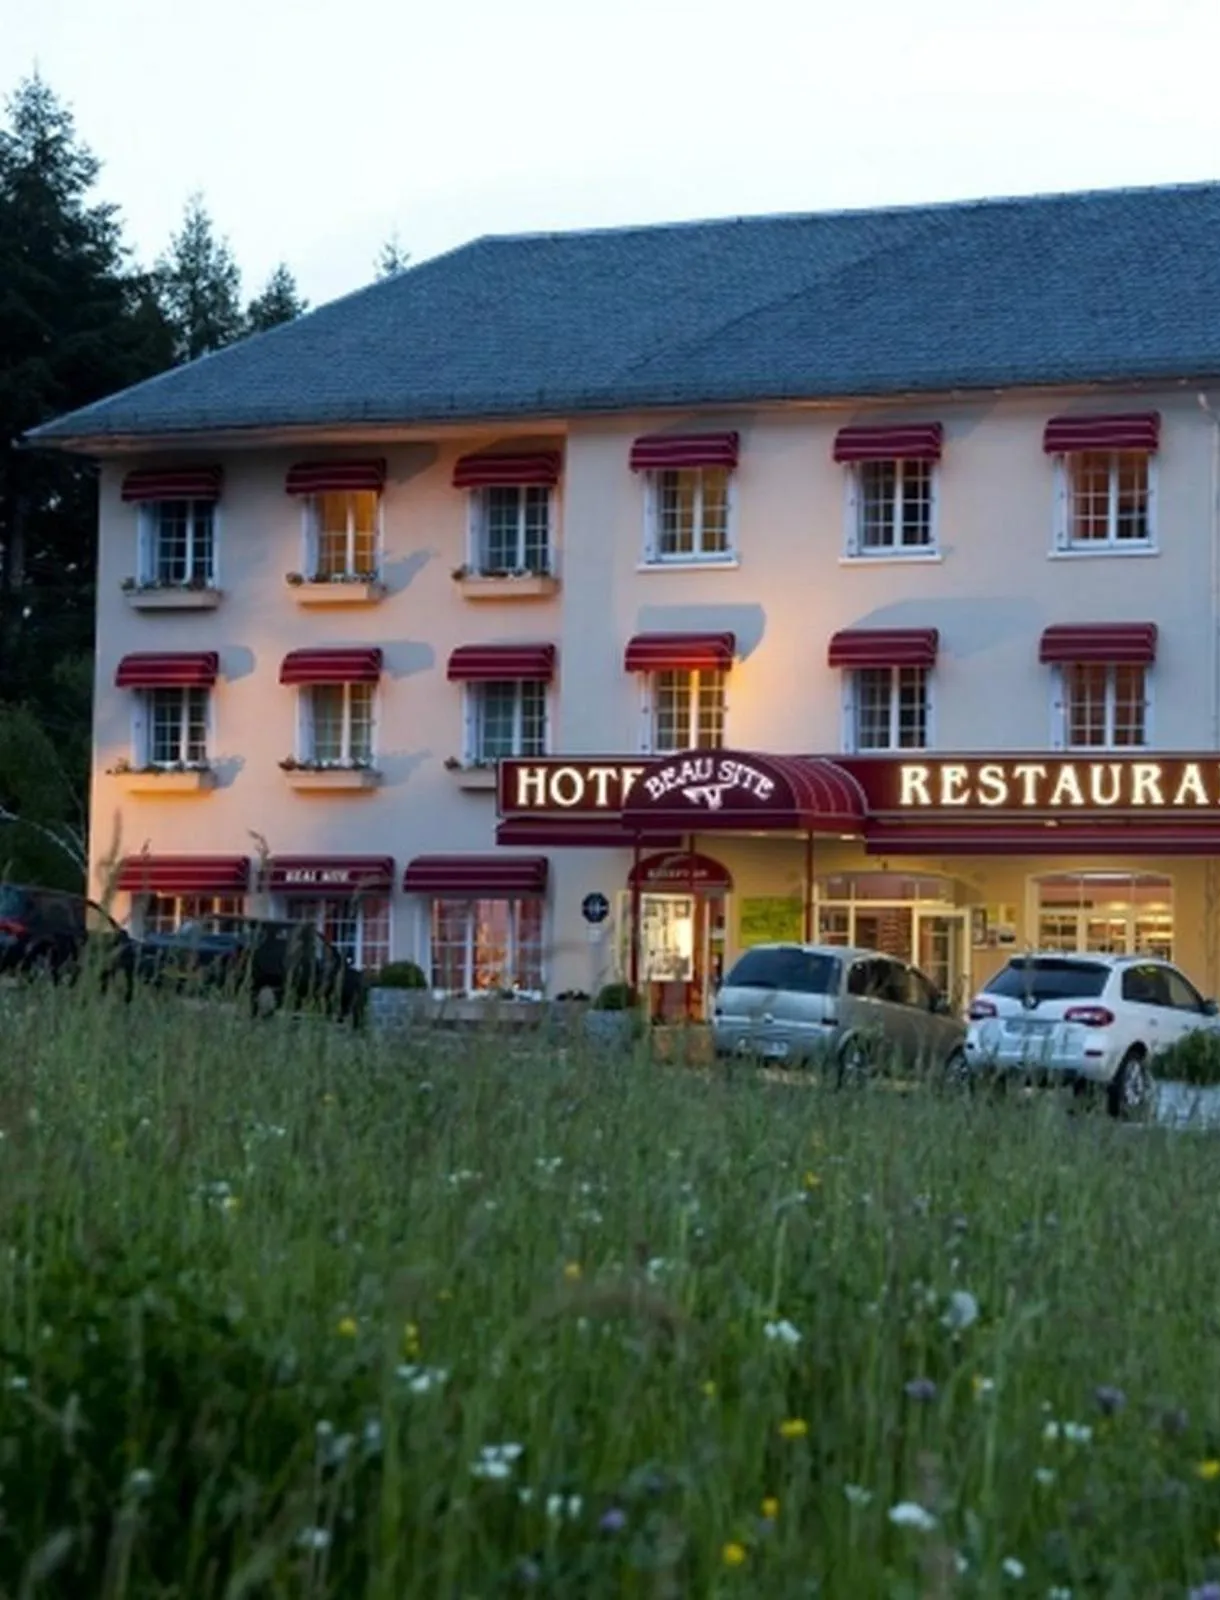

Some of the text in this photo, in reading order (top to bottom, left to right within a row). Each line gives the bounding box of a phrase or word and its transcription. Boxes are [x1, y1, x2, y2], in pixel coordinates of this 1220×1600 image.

[516, 766, 645, 807] HOTE
[644, 757, 775, 800] BEAU SITE
